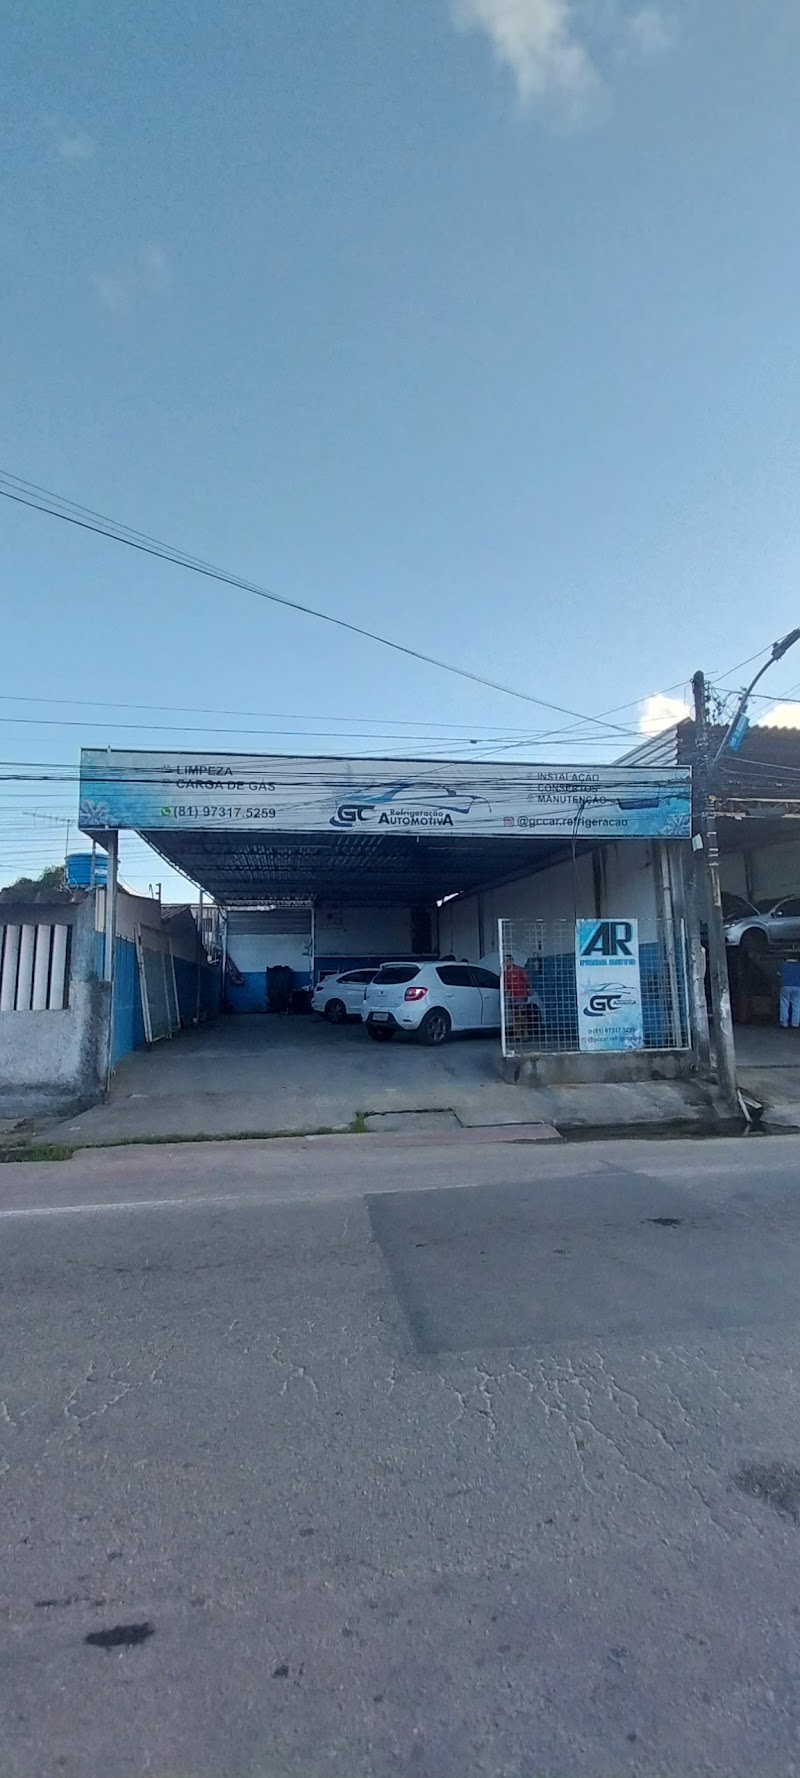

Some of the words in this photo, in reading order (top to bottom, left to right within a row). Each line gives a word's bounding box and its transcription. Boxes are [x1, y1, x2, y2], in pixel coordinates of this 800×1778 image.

[176, 765, 233, 776] LIMPEZA
[537, 772, 600, 782] INSTALAÇÃO
[176, 779, 223, 790] CARGA
[227, 780, 244, 790] DE
[248, 779, 276, 791] GÁS
[537, 794, 607, 805] MANUTENÇÃO
[173, 806, 199, 818] (81)
[337, 804, 376, 821] GC
[390, 808, 443, 818] Refrigeração
[580, 921, 634, 956] AR
[589, 994, 623, 1011] GC
